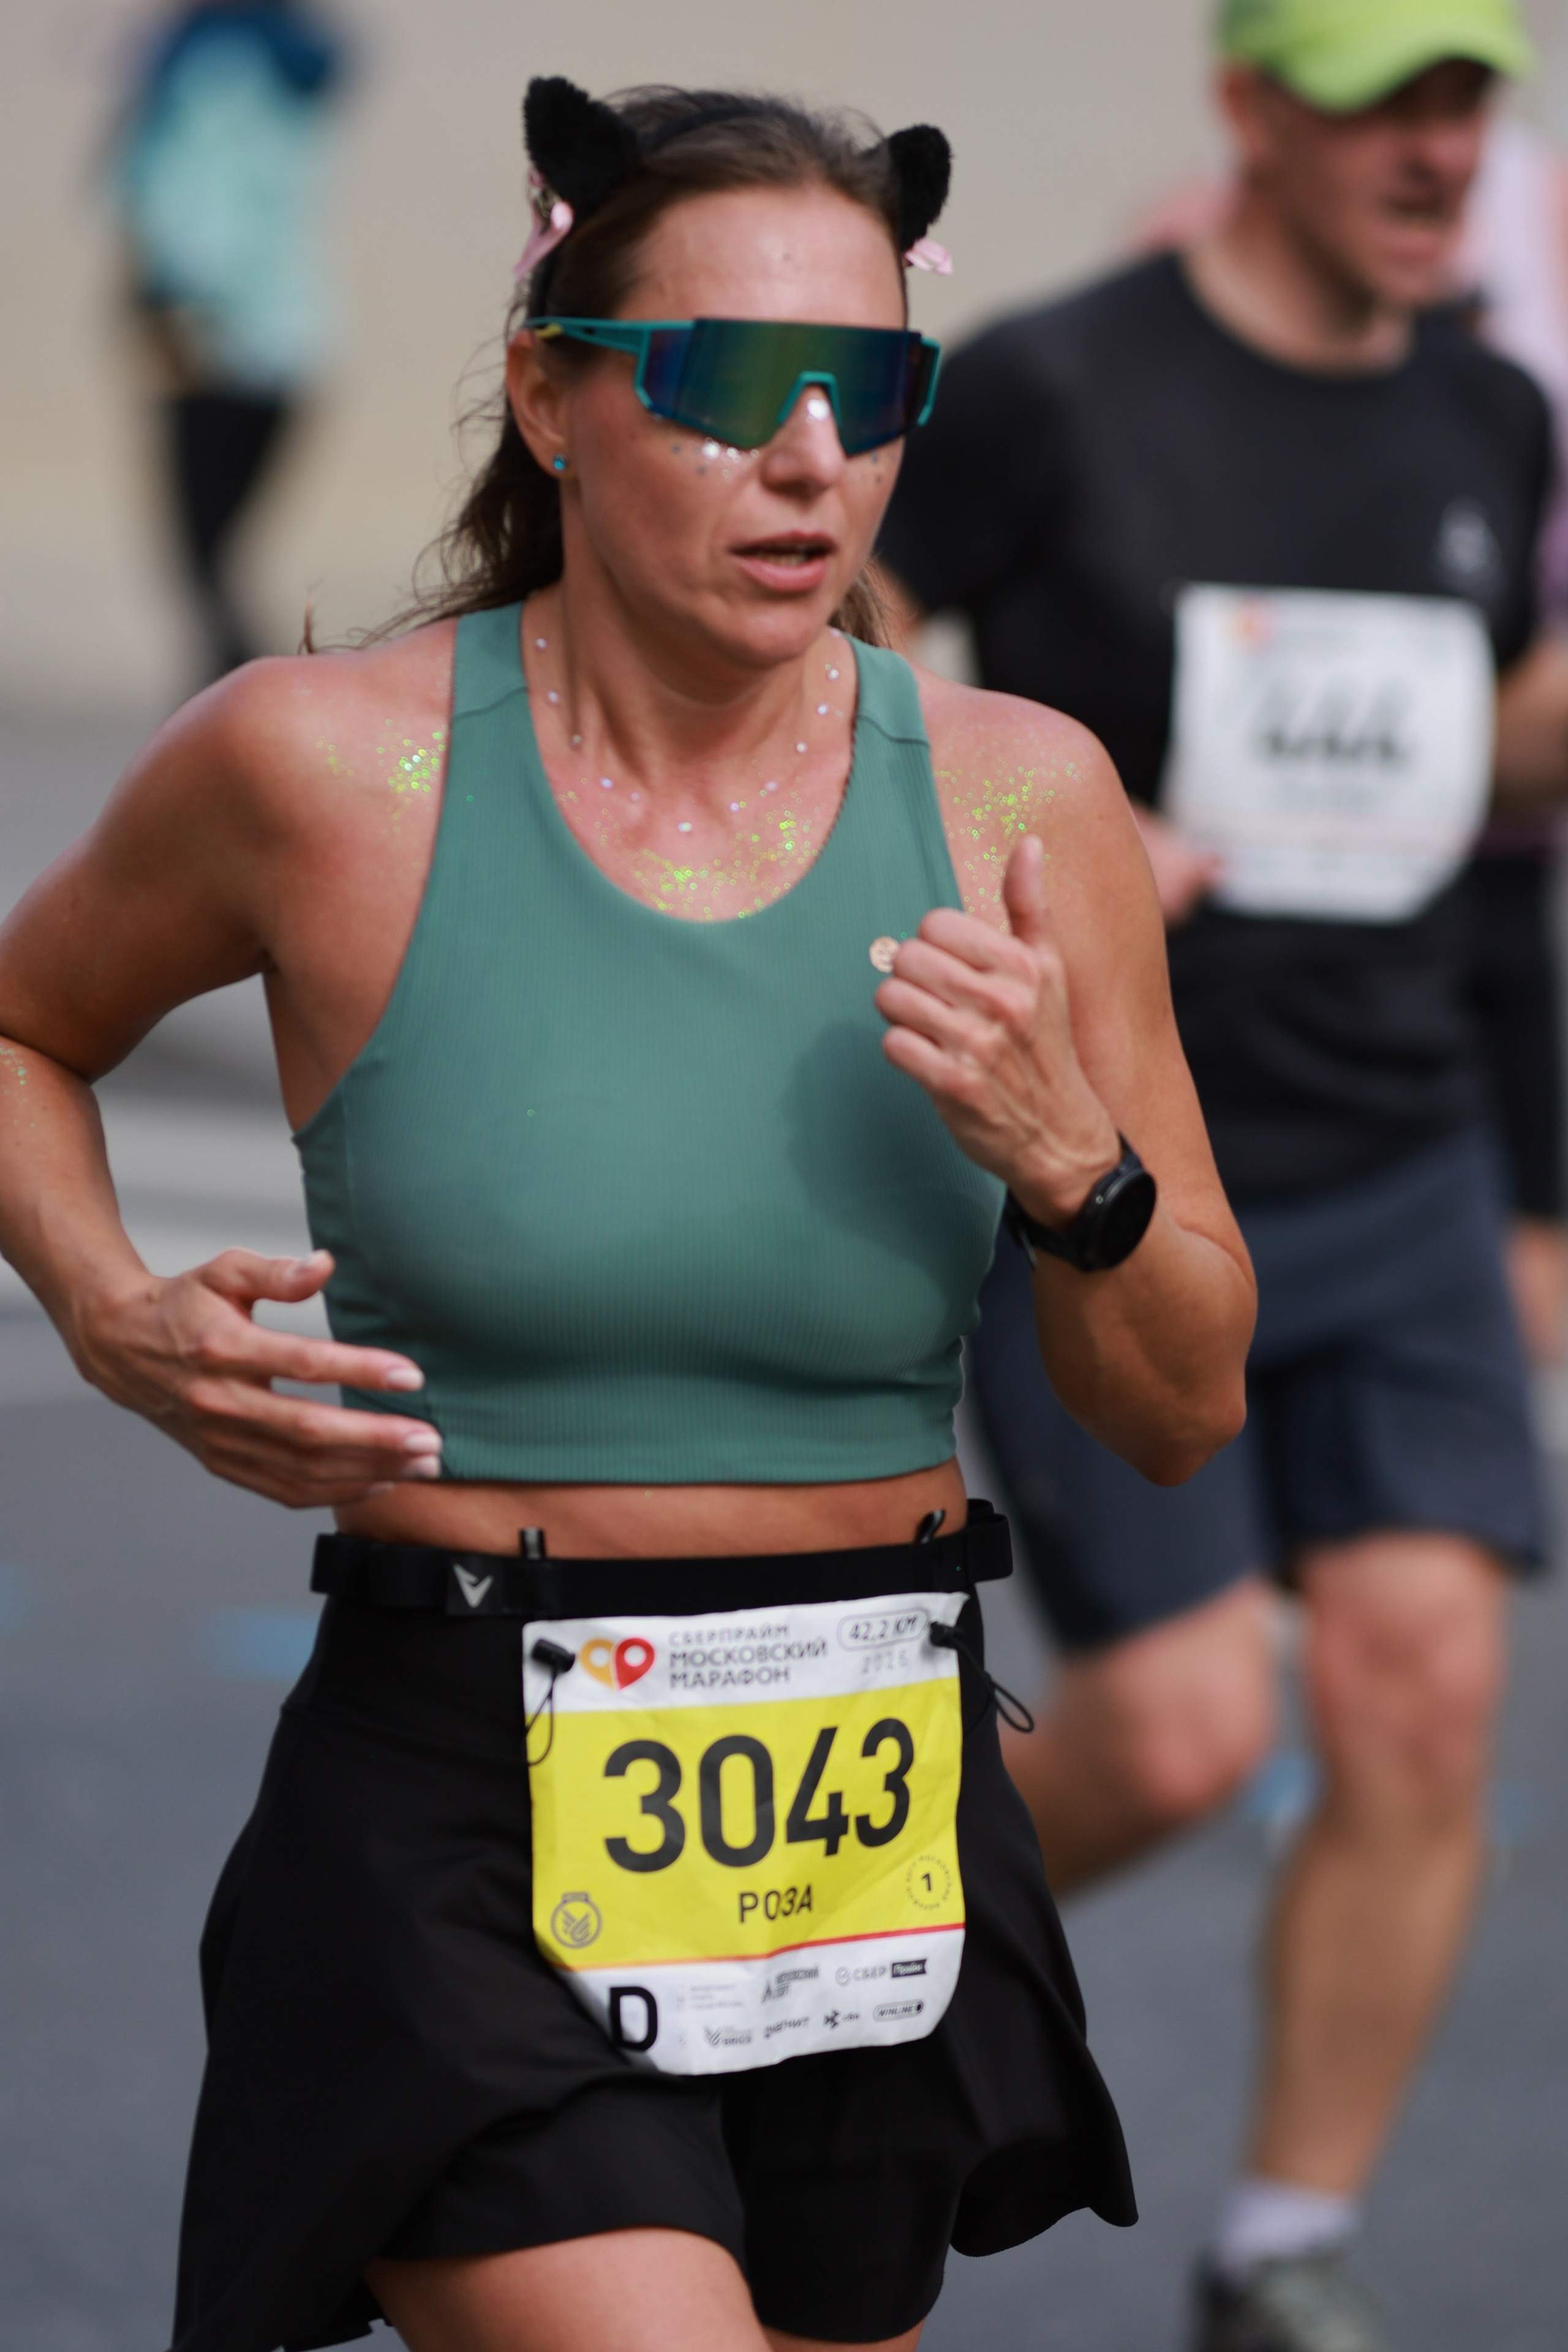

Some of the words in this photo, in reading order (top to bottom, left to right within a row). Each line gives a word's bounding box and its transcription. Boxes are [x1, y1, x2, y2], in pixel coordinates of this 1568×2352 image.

[668, 1622, 790, 1648] СБЕРПРАЙМ
[670, 1636, 827, 1669] МОСКОВСКИЙ
[670, 1666, 790, 1690] МАРАФОН
[603, 1717, 914, 1873] 3043
[921, 1872, 932, 1892] 1
[609, 1986, 658, 2052] D
